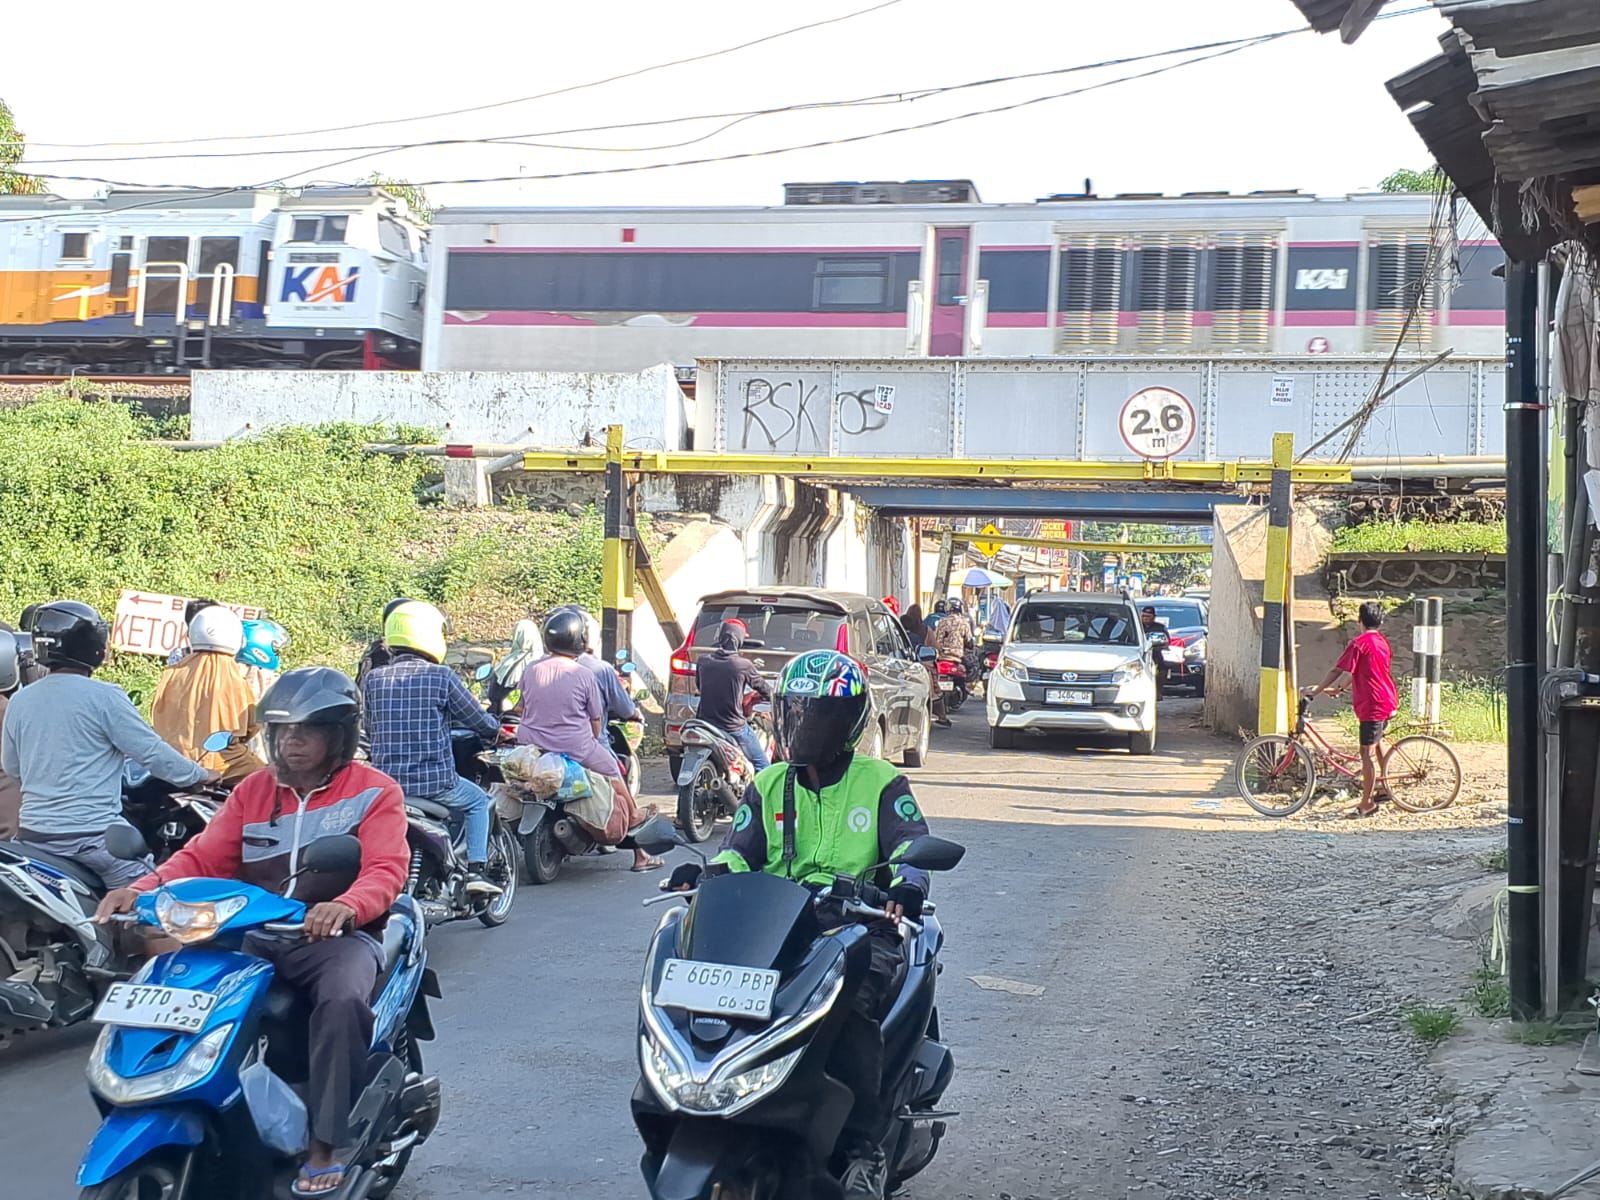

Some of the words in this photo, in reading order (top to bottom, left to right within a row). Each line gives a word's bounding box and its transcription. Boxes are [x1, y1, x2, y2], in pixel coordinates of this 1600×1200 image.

[279, 266, 361, 302] KAI
[1295, 269, 1349, 289] KAI
[878, 385, 894, 394] 1927
[1152, 438, 1165, 447] m
[665, 963, 677, 981] E
[687, 966, 733, 986] 6059
[739, 972, 774, 991] PBP
[106, 986, 122, 1003] E
[127, 987, 172, 1006] 5770
[187, 993, 214, 1011] SJ
[694, 1017, 728, 1026] HONDA
